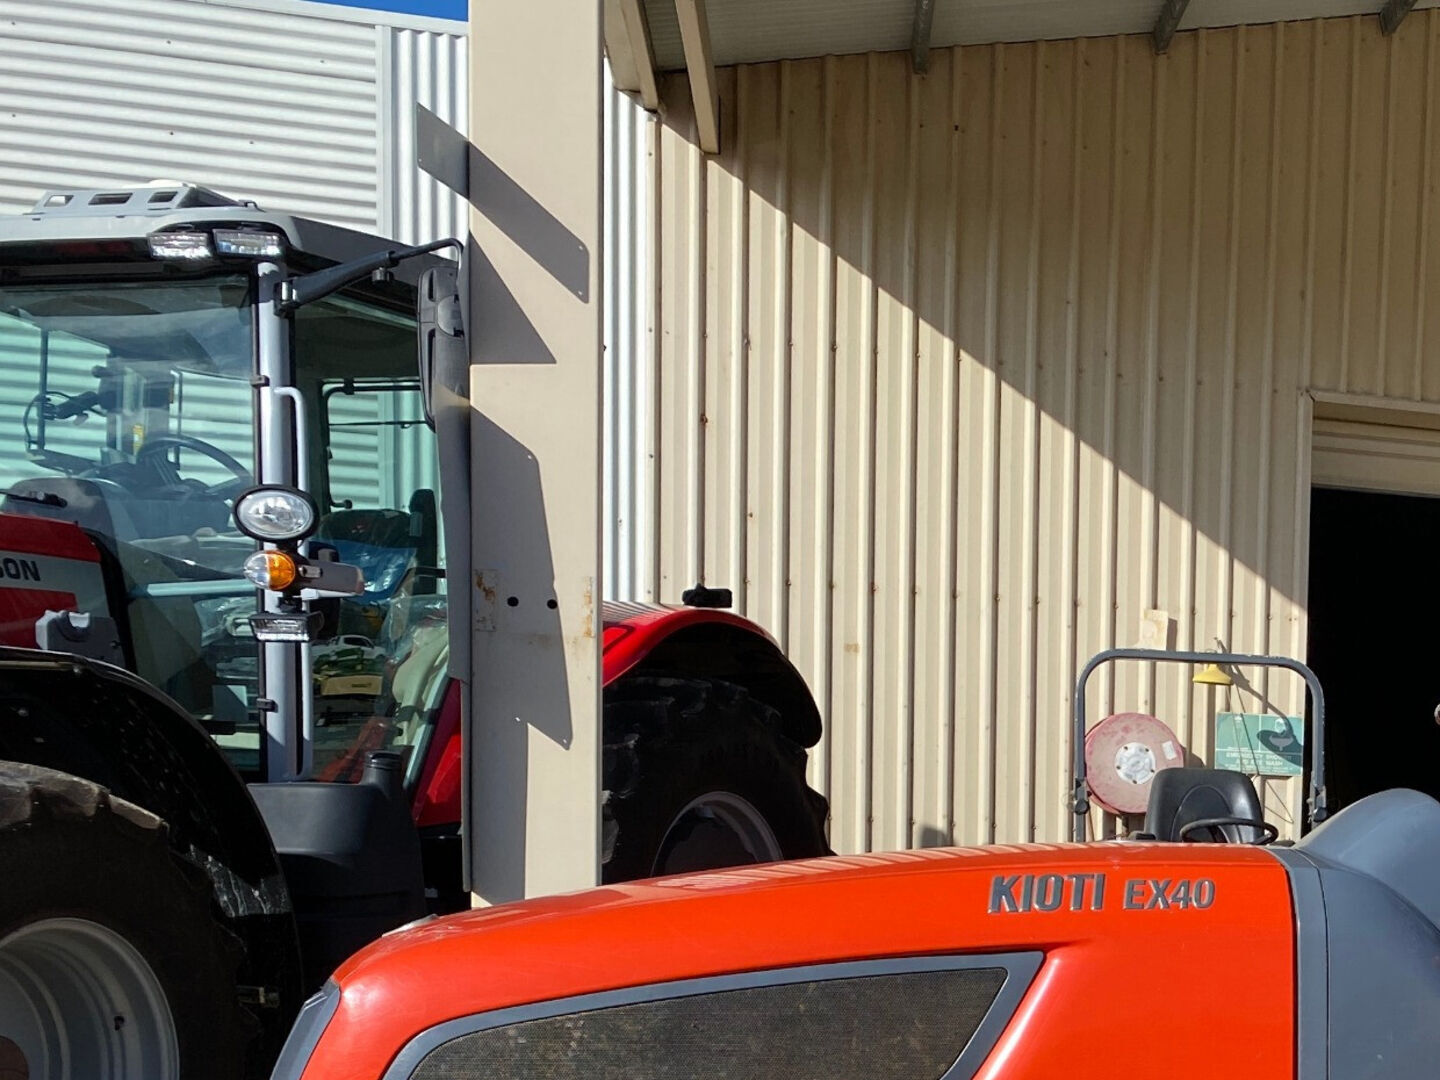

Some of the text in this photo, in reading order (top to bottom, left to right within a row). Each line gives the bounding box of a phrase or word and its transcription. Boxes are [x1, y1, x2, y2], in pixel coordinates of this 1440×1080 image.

[0, 557, 41, 581] ON
[987, 873, 1216, 914] KIOTI EX40
